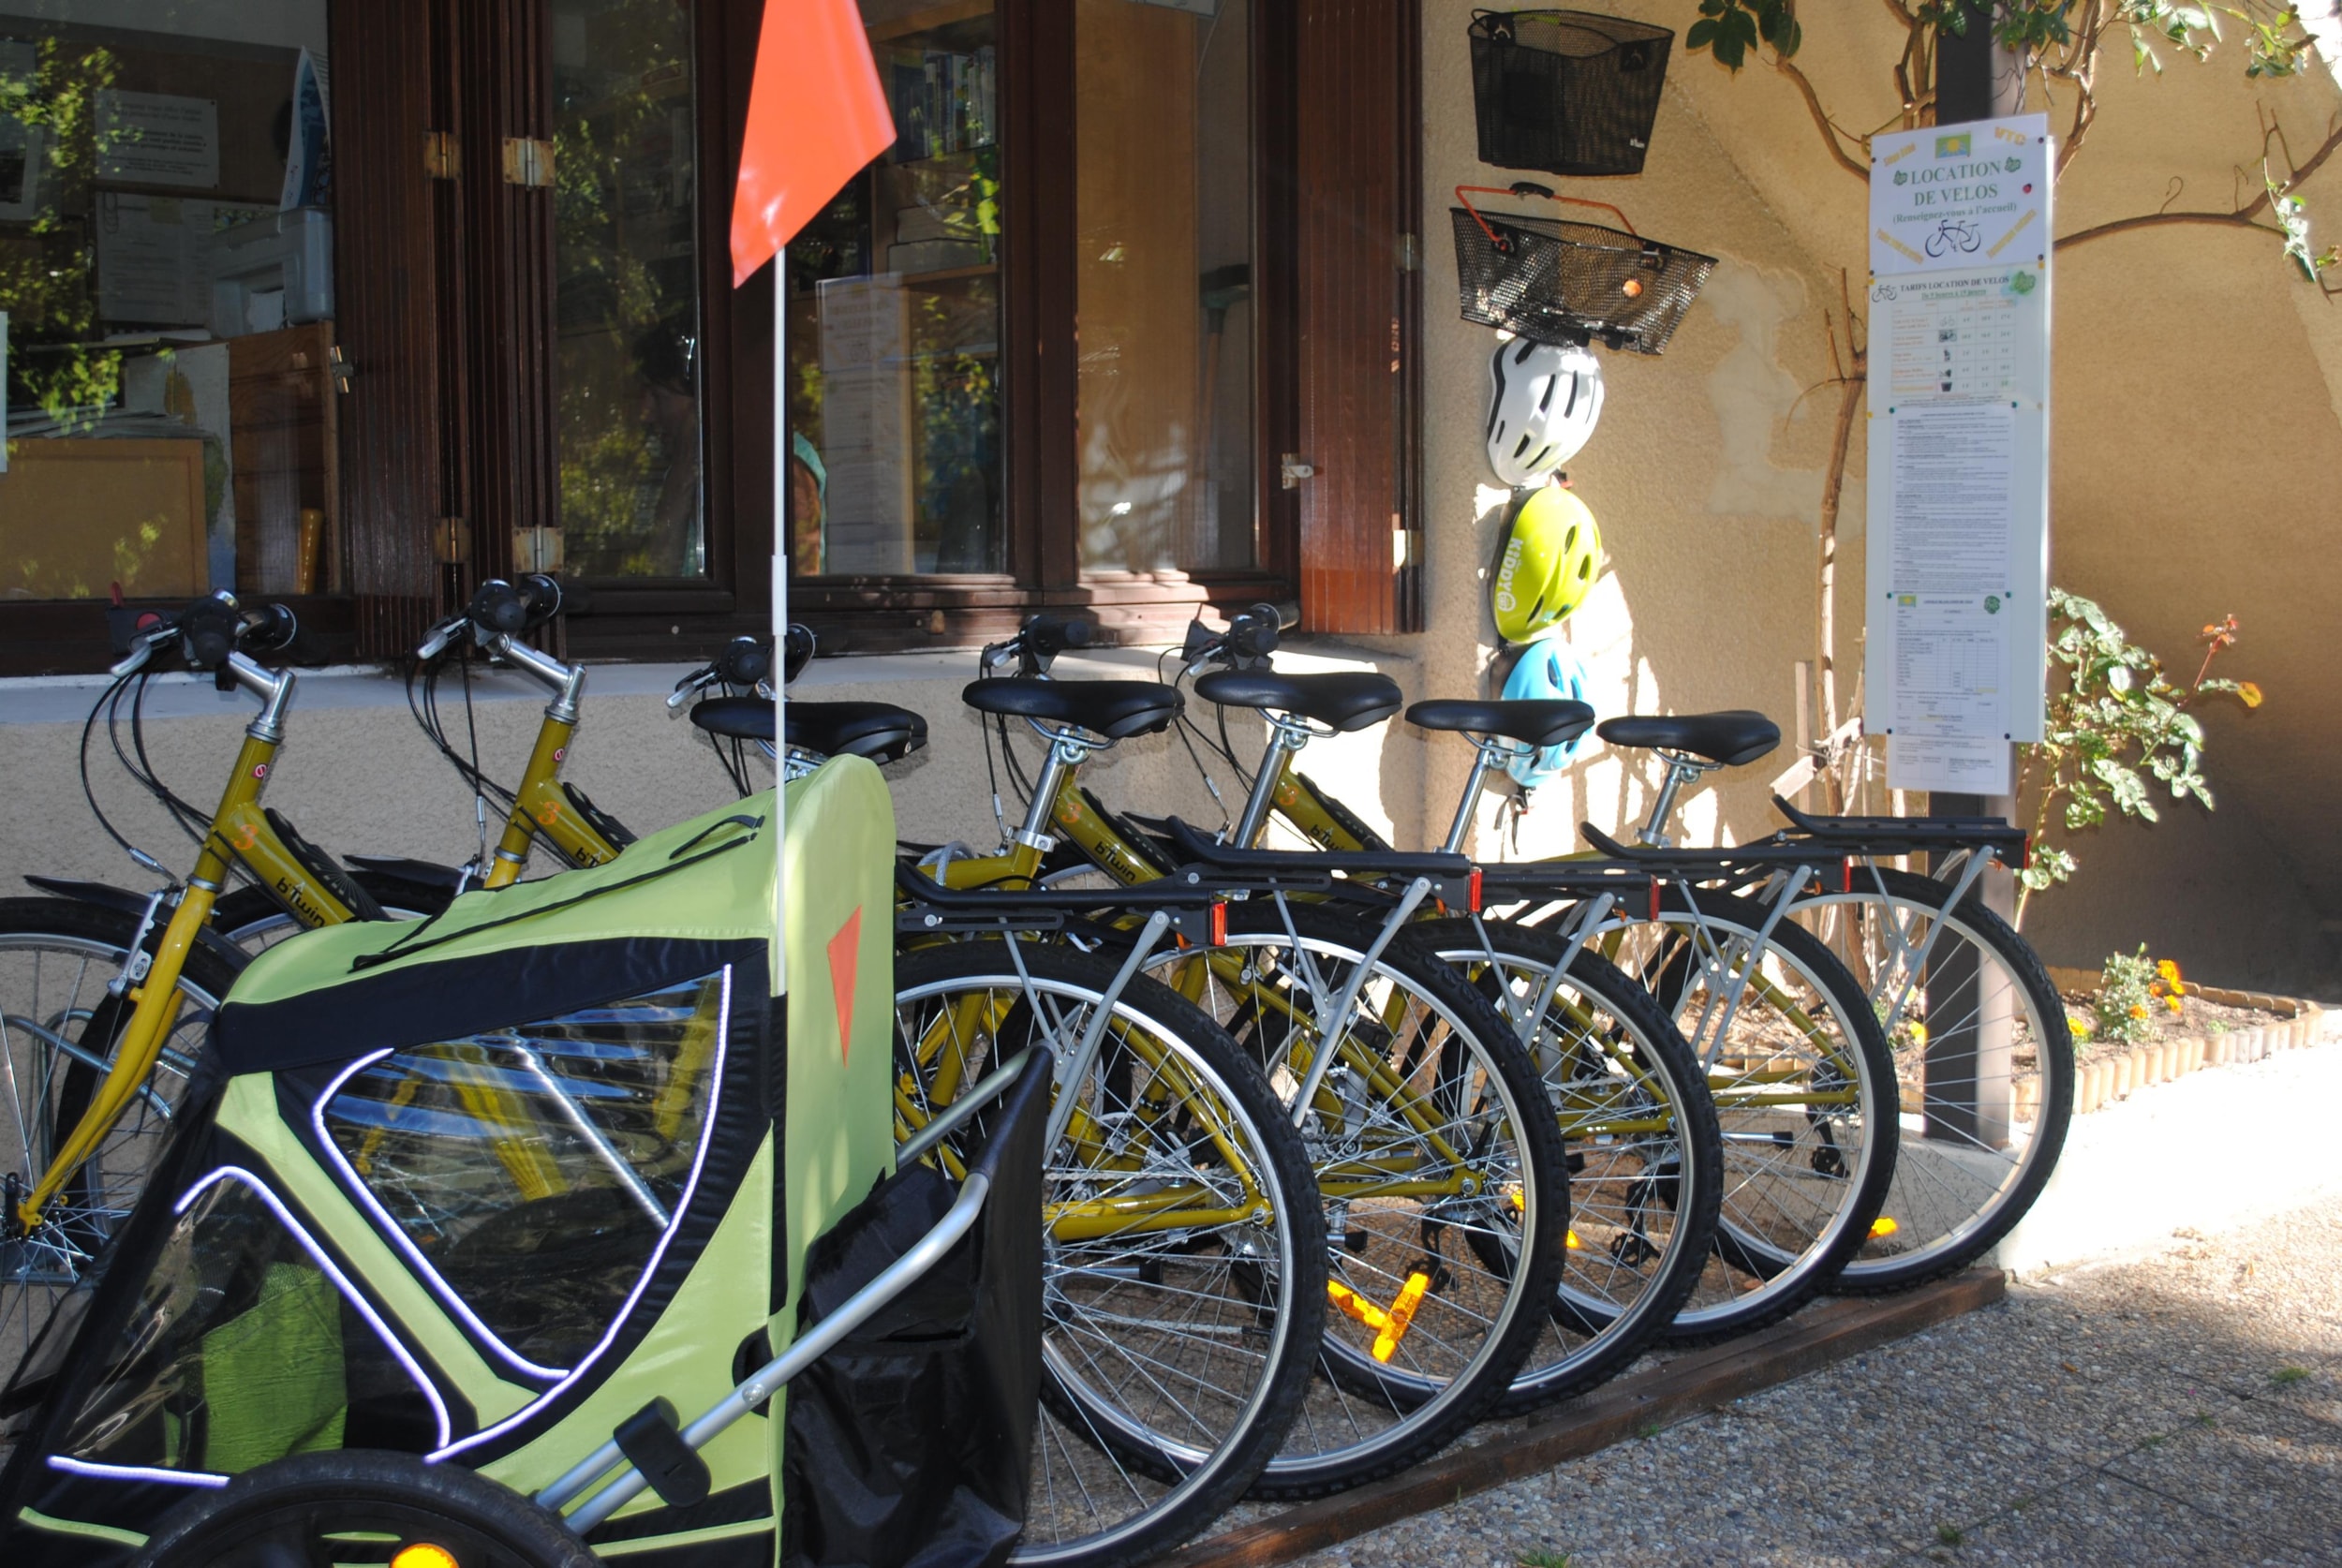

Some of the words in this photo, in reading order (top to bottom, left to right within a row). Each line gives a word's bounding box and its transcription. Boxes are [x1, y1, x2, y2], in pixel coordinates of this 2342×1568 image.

[1911, 160, 2001, 185] LOCATION
[1914, 190, 1935, 206] DE
[1941, 184, 1998, 203] VELOS
[1279, 785, 1299, 806] 3
[538, 801, 560, 824] 3
[1060, 802, 1082, 823] 3
[233, 824, 259, 851] 3
